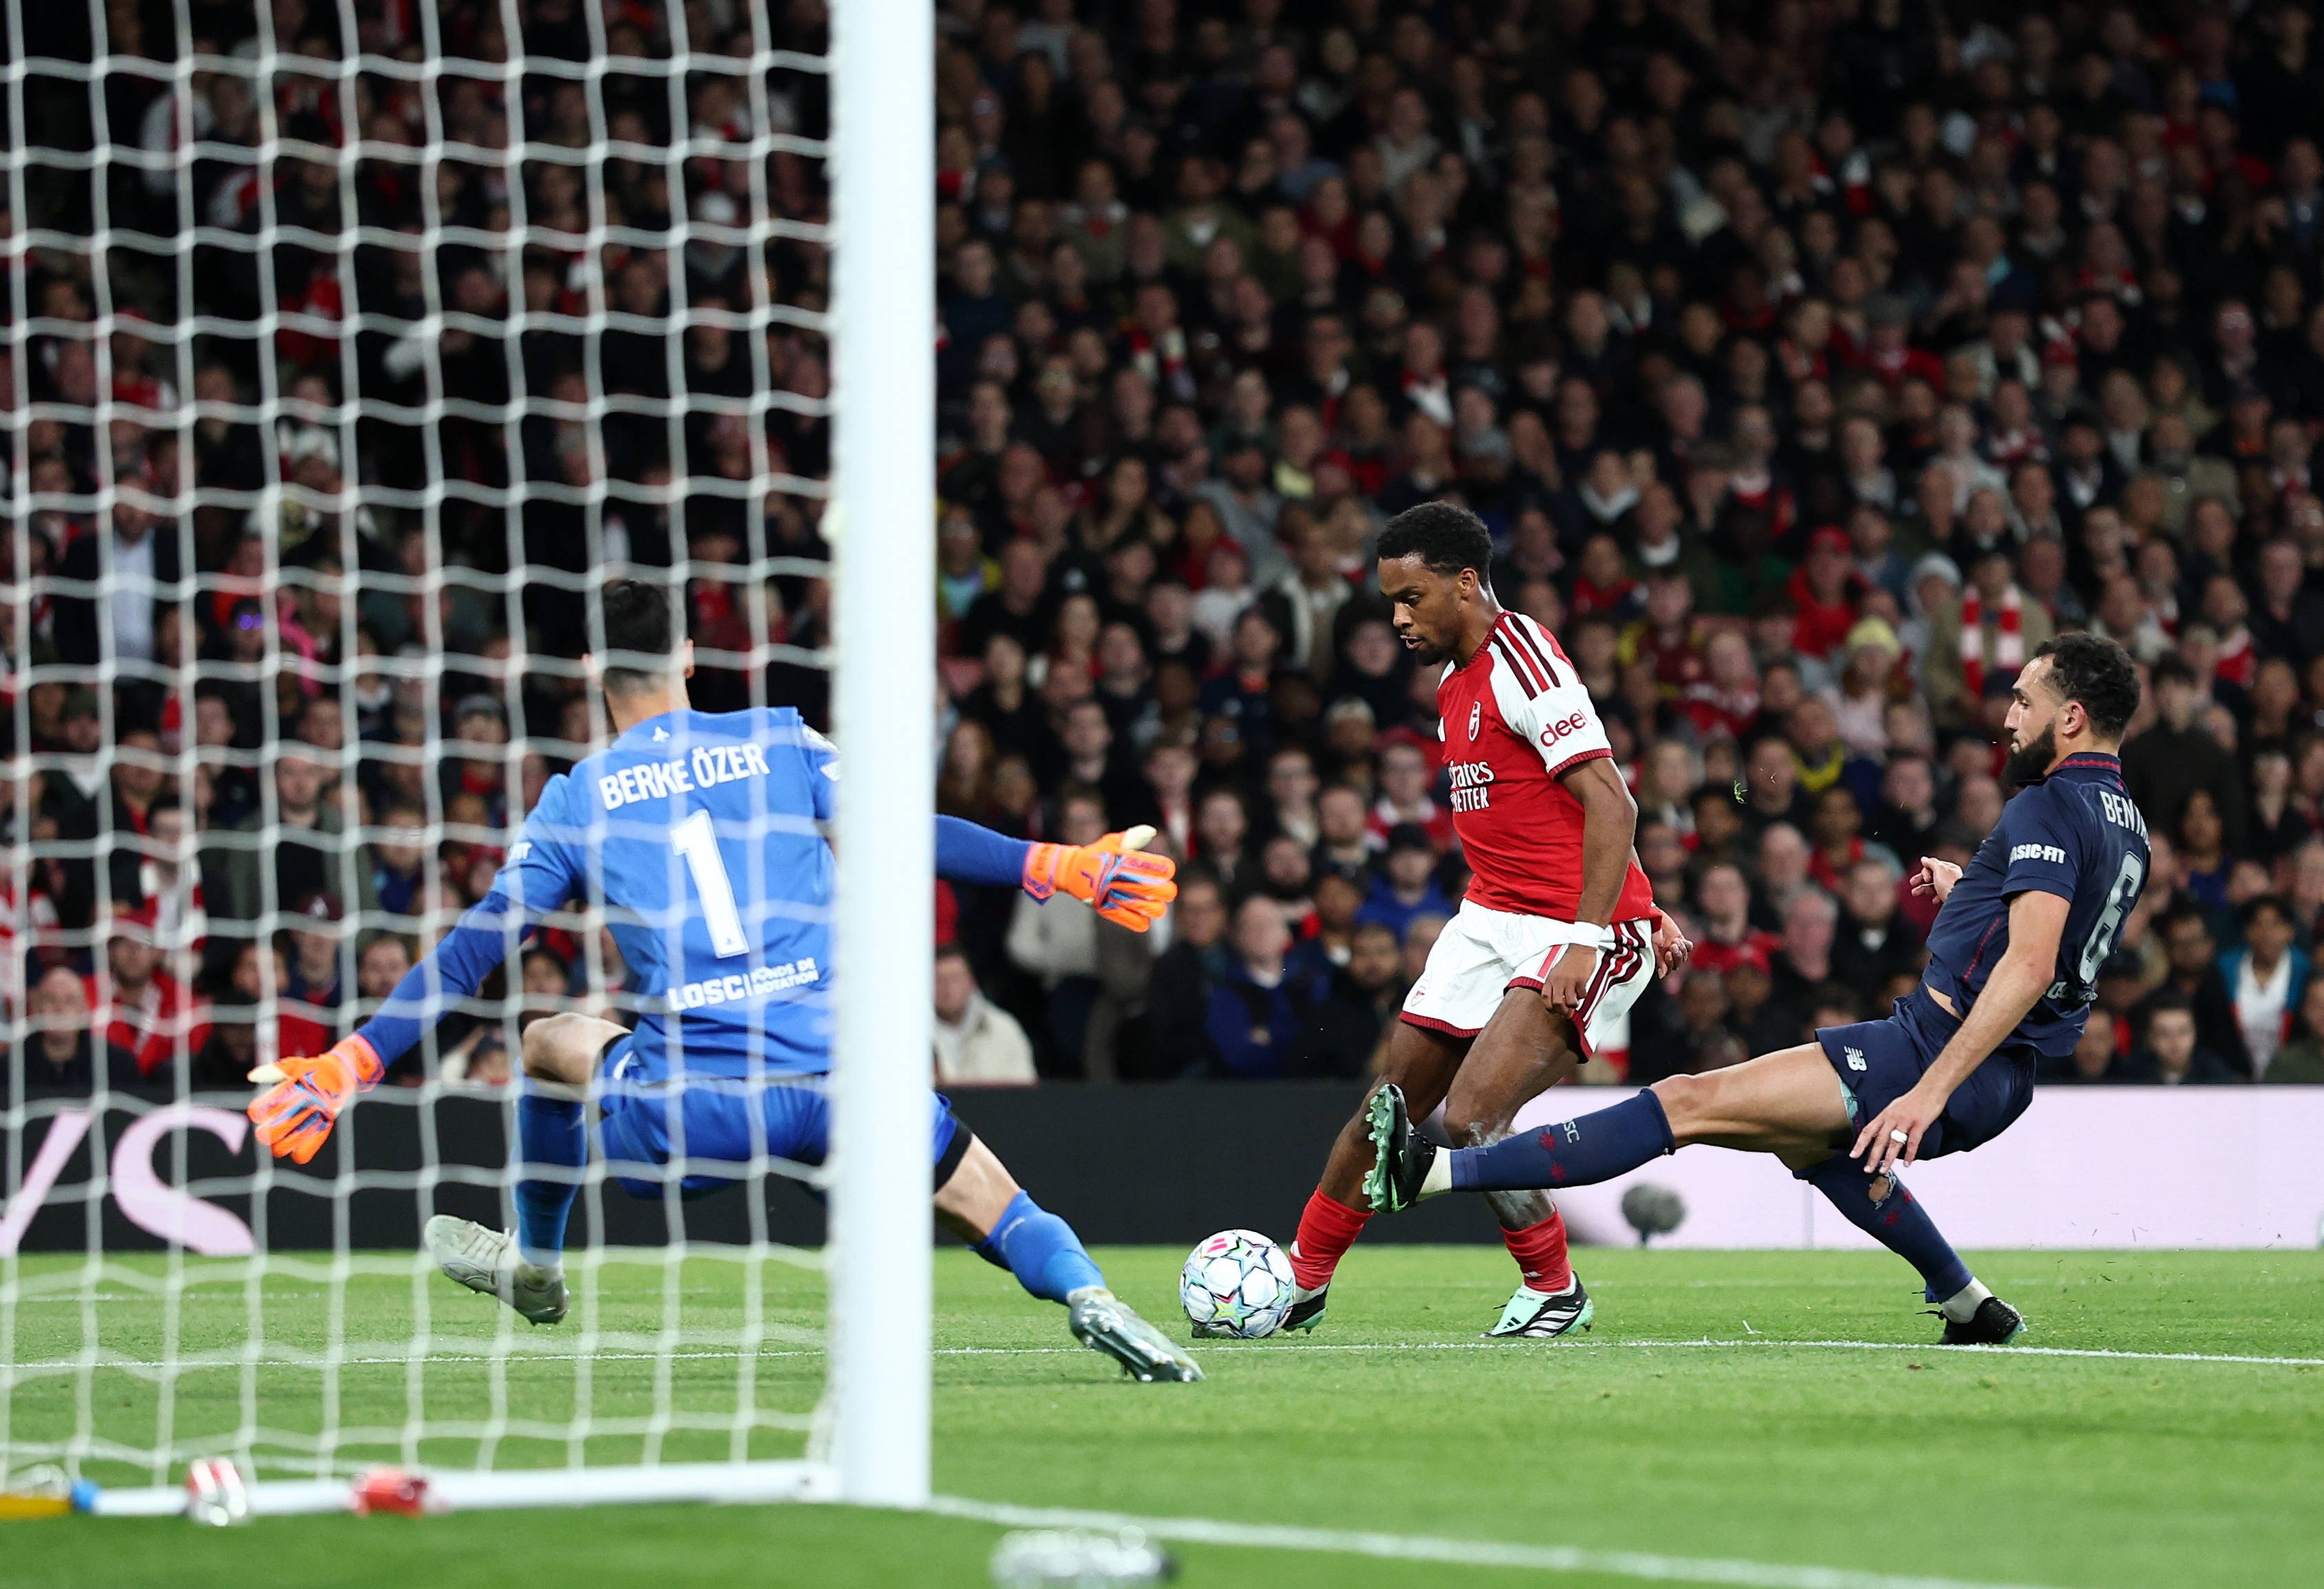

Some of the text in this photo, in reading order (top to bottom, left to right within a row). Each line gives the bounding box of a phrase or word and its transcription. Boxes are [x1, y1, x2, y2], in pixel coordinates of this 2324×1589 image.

[598, 742, 771, 811] BERKE ÖZER
[669, 809, 750, 959] 1
[2009, 843, 2066, 867] ASIC-FIT
[2079, 851, 2142, 984] 6
[667, 975, 745, 1011] LOSC
